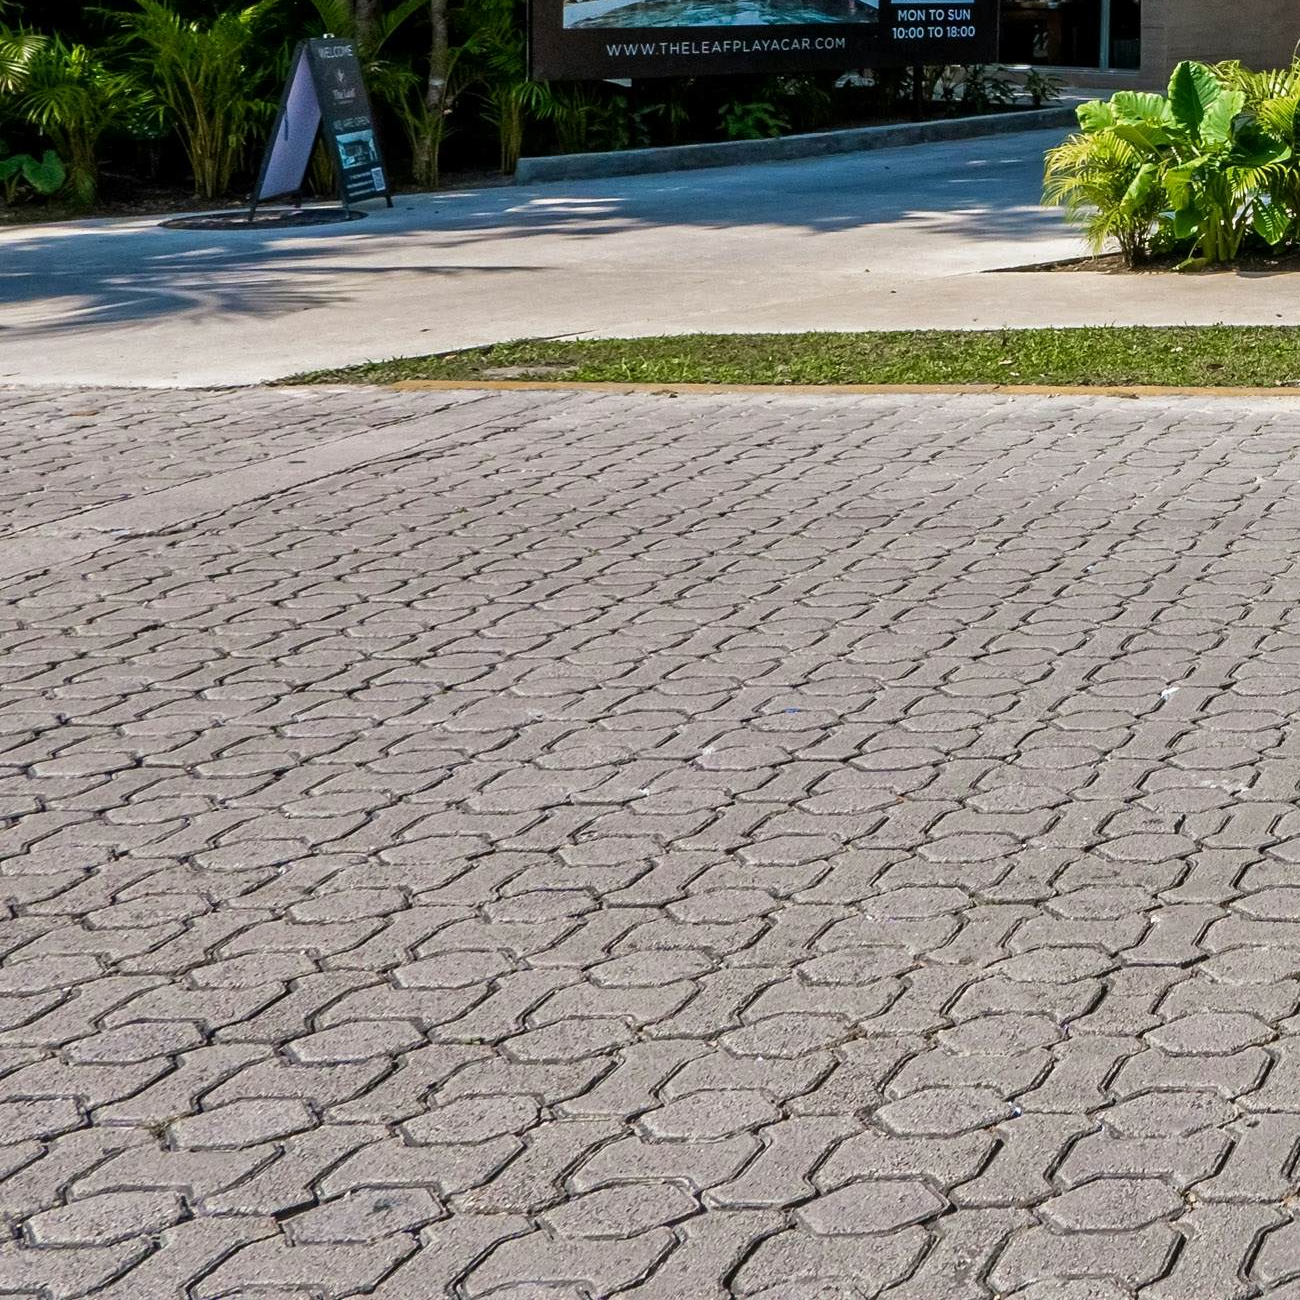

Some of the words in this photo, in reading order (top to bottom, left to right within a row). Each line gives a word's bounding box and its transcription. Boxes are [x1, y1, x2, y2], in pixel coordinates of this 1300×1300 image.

[897, 9, 926, 21] MON
[929, 8, 945, 21] TO
[947, 8, 971, 21] SUN
[892, 27, 925, 39] 10:00
[927, 26, 943, 38] TO
[946, 26, 976, 38] 18:00
[606, 37, 846, 56] WWW.THELEAFPLAYACAR.COM
